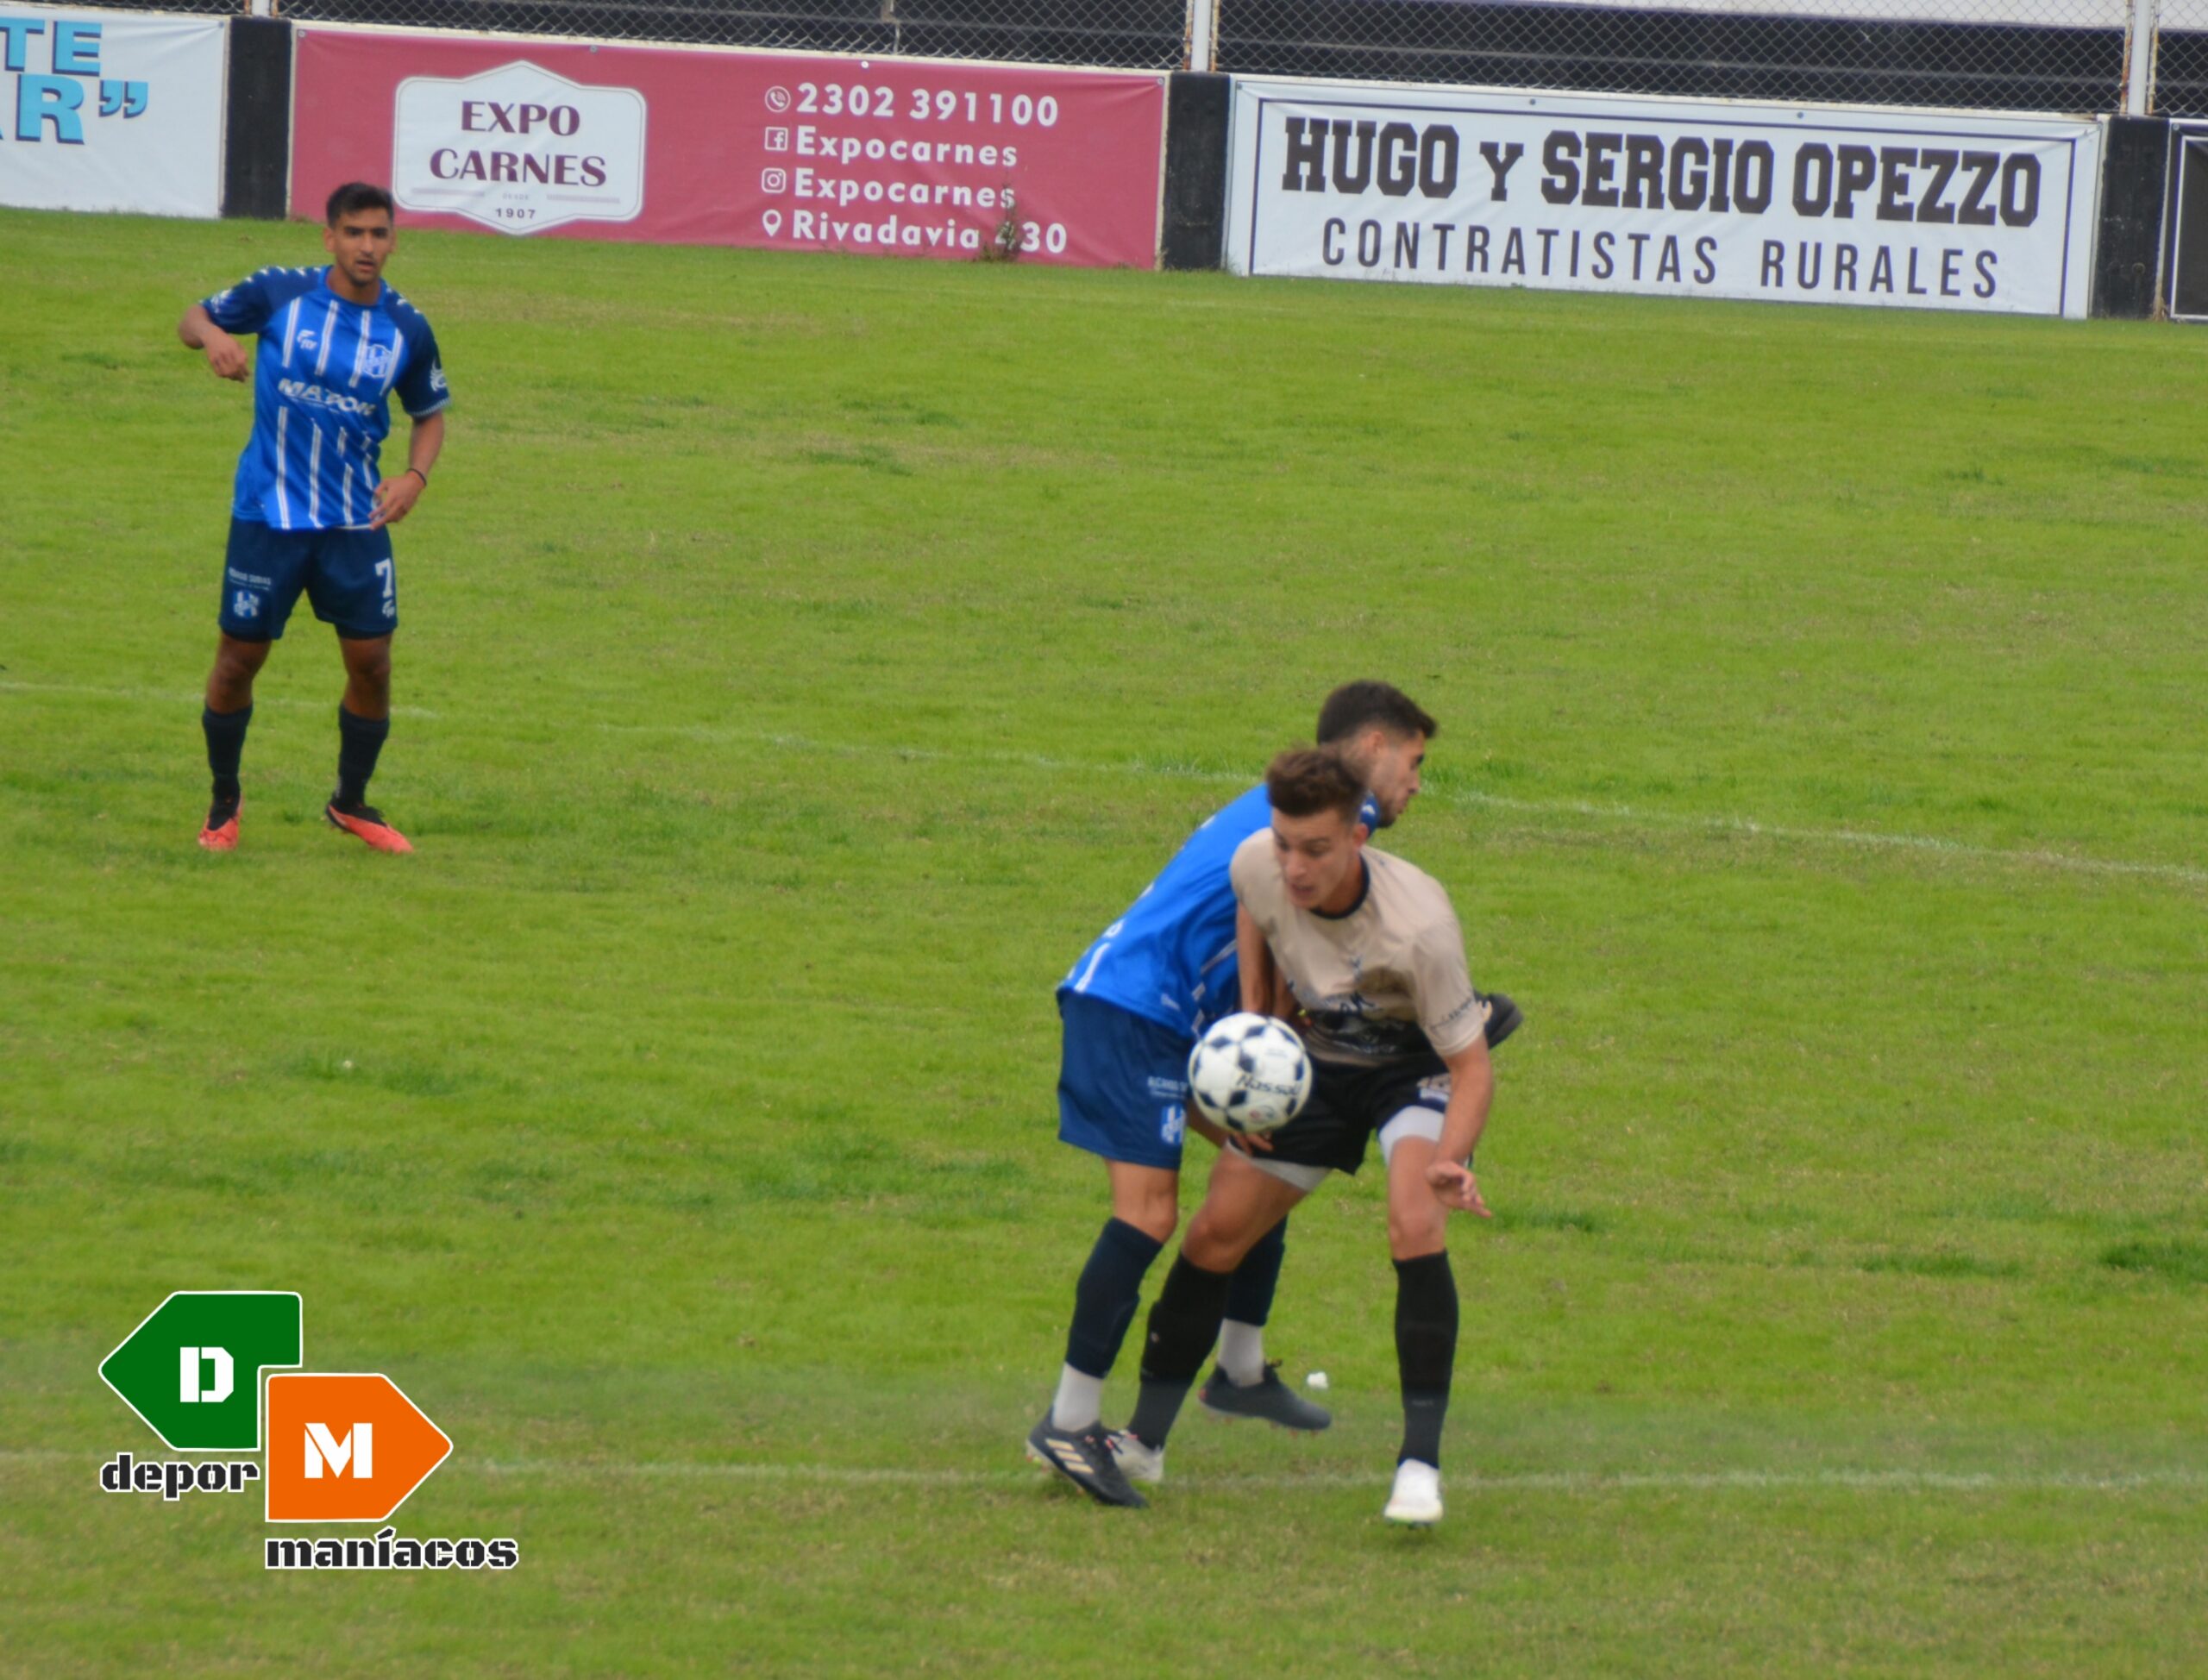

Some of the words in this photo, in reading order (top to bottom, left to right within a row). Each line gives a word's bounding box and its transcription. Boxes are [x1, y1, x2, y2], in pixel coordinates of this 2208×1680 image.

[0, 73, 149, 145] R”
[461, 100, 580, 136] EXPO
[796, 82, 895, 117] 2302
[909, 89, 1059, 127] 391100
[796, 125, 1019, 166] Expocarnes
[429, 147, 607, 187] CARNES
[1282, 116, 1459, 198] HUGO
[1478, 141, 1524, 202] Y
[1540, 129, 1775, 215] SERGIO
[1791, 141, 2042, 228] OPEZZO
[794, 167, 1016, 209] Expocarnes
[495, 208, 536, 219] 1907
[792, 209, 981, 248] Rivadavia
[1322, 217, 1717, 285] CONTRATISTAS
[1760, 239, 1998, 298] RURALES
[374, 558, 393, 598] 7
